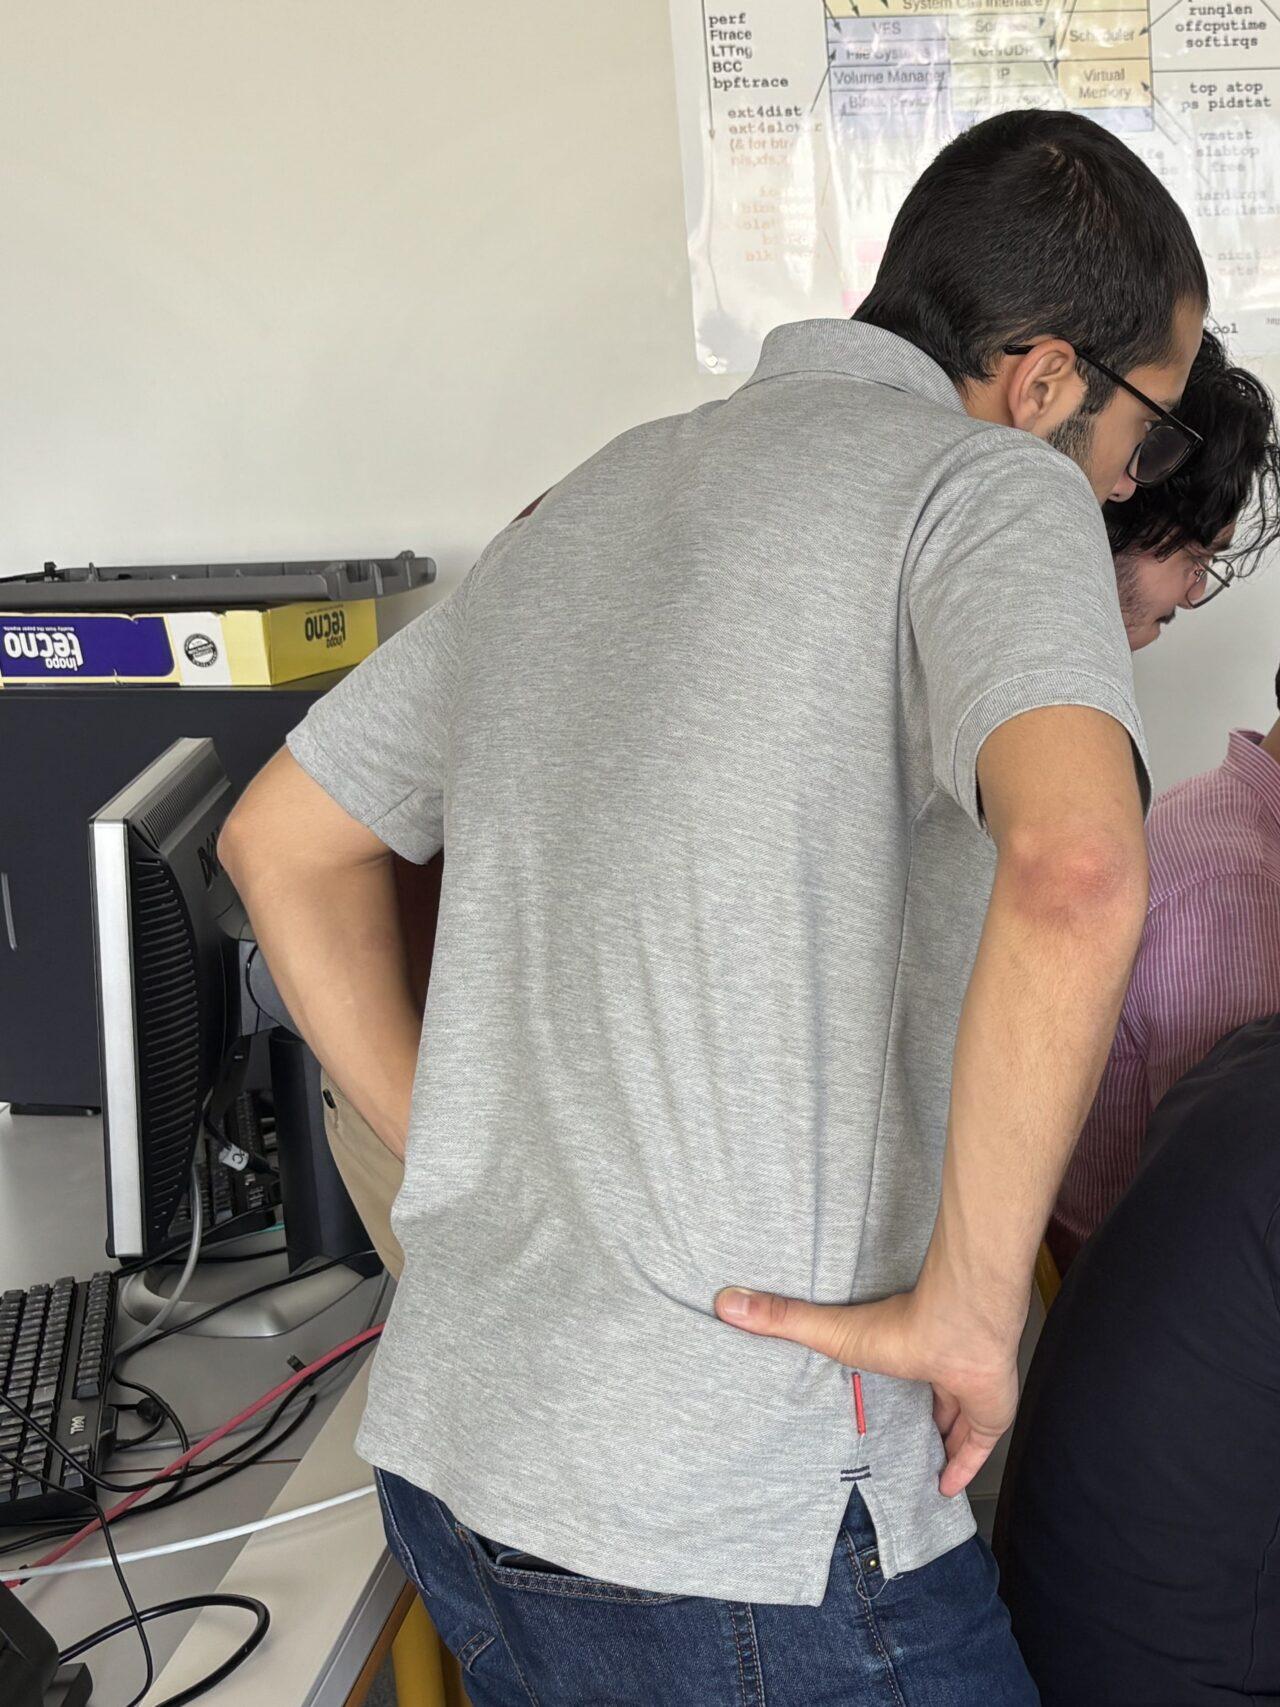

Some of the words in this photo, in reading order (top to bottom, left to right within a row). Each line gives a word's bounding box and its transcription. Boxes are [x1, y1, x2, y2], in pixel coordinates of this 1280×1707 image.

[1189, 3, 1253, 18] runqlen
[709, 12, 746, 28] perf
[1175, 19, 1267, 34] offcputime
[710, 29, 752, 41] Ftrace
[872, 21, 902, 35] VFS
[1069, 29, 1134, 43] Schduler
[1186, 35, 1258, 50] softirqs
[711, 45, 753, 59] LTTng
[713, 60, 742, 73] BCC
[833, 70, 884, 85] Volume
[1084, 67, 1126, 82] Virtual
[713, 76, 789, 91] bpftrace
[1190, 82, 1217, 96] top
[1226, 81, 1263, 95] atop
[728, 105, 802, 118] ext4dist
[1182, 101, 1199, 113] ps
[1208, 96, 1272, 112] pidstat
[305, 610, 346, 642] tecno
[4, 632, 84, 666] tecno
[45, 654, 78, 671] inapa
